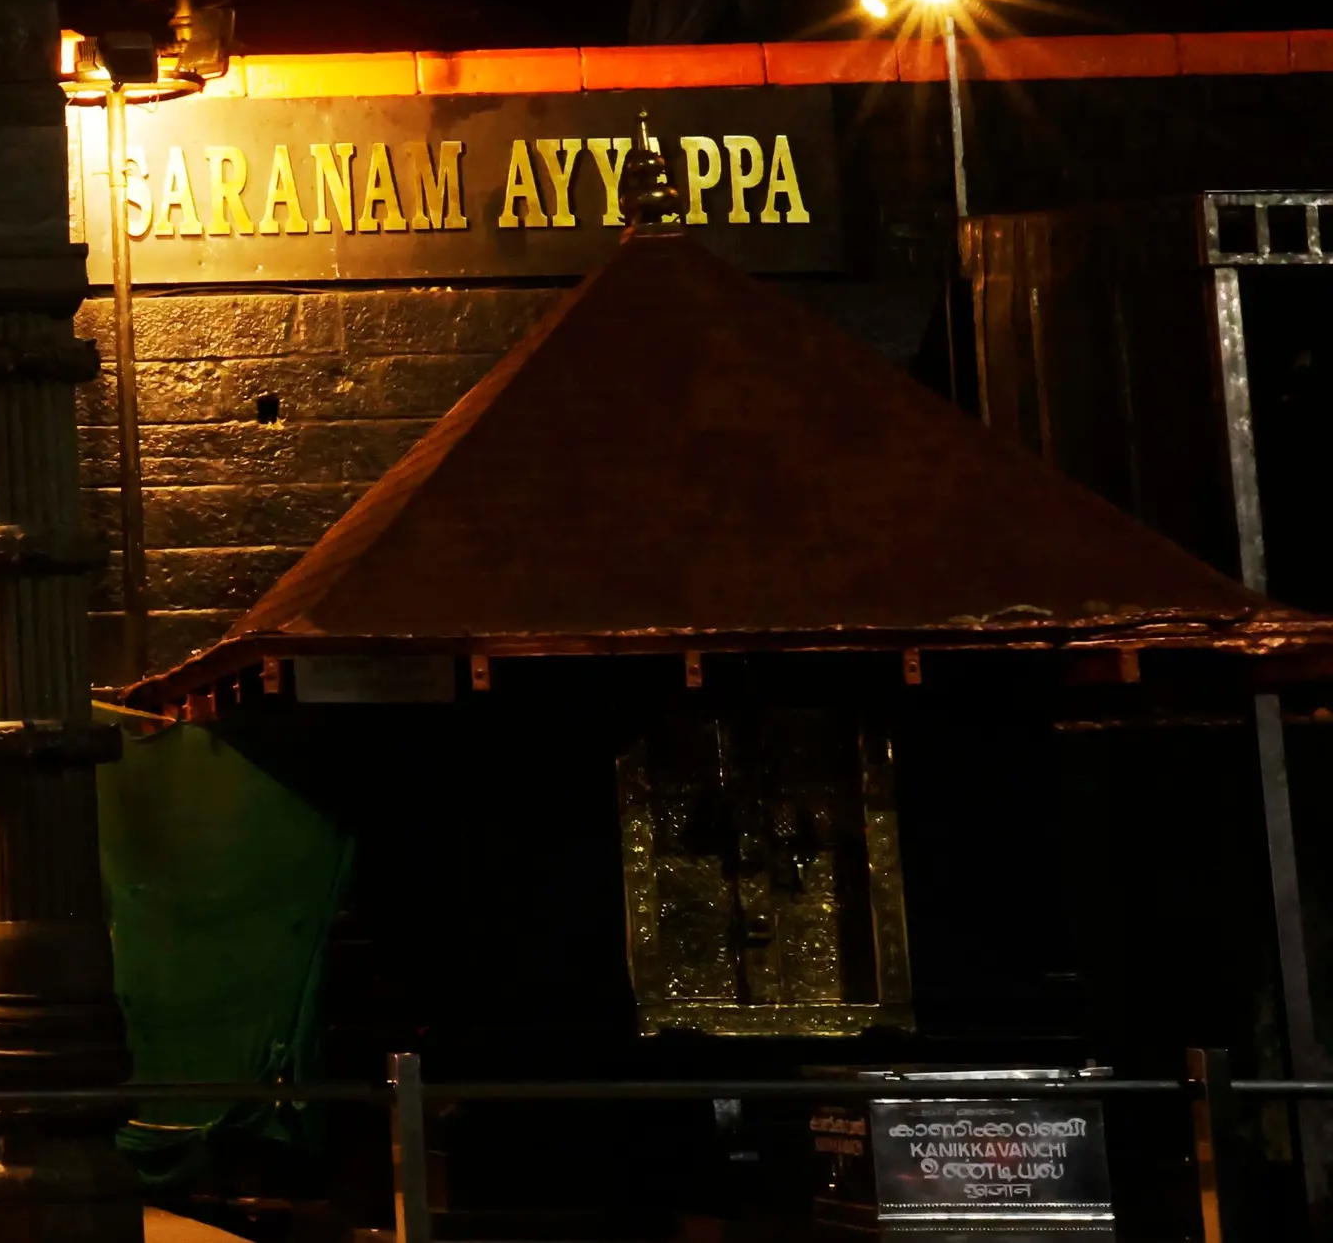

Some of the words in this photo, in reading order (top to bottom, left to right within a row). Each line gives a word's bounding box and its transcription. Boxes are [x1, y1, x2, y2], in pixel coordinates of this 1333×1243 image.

[126, 141, 467, 237] SARANAM
[498, 134, 810, 229] AYYPPA
[910, 1142, 1067, 1158] KANIKKAVANCHI
